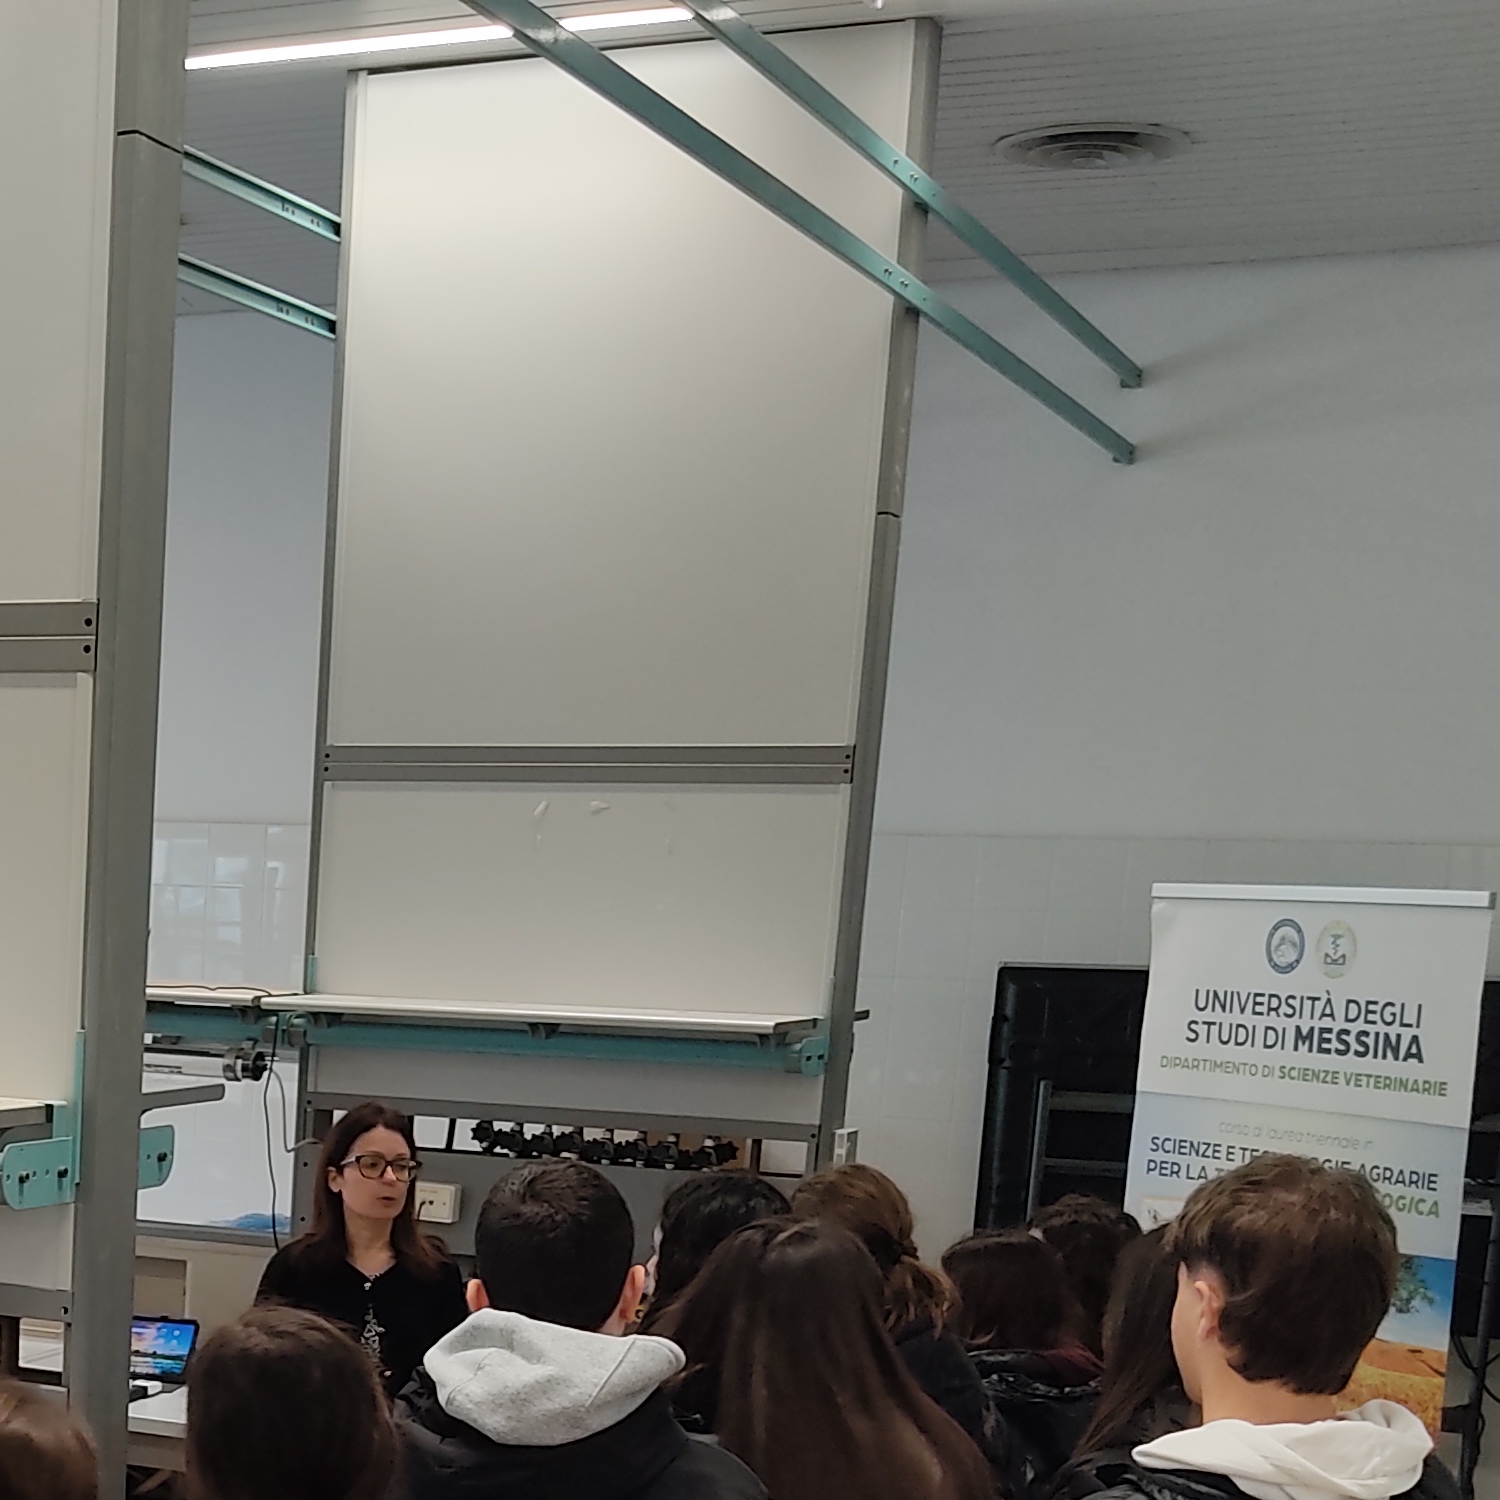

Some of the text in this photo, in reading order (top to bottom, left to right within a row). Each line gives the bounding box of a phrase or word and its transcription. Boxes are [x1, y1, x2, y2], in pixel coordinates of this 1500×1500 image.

[1194, 988, 1423, 1029] UNIVERSITÀ DEGLI
[1185, 1020, 1425, 1064] STUDI DI MESSINA
[1160, 1055, 1448, 1097] DIPARTIMENTO DI SCIENZE VETERINARIE
[1218, 1121, 1250, 1137] corso
[1149, 1136, 1223, 1161] SCIENZE
[1226, 1145, 1236, 1162] E
[1145, 1159, 1208, 1181] PER LA
